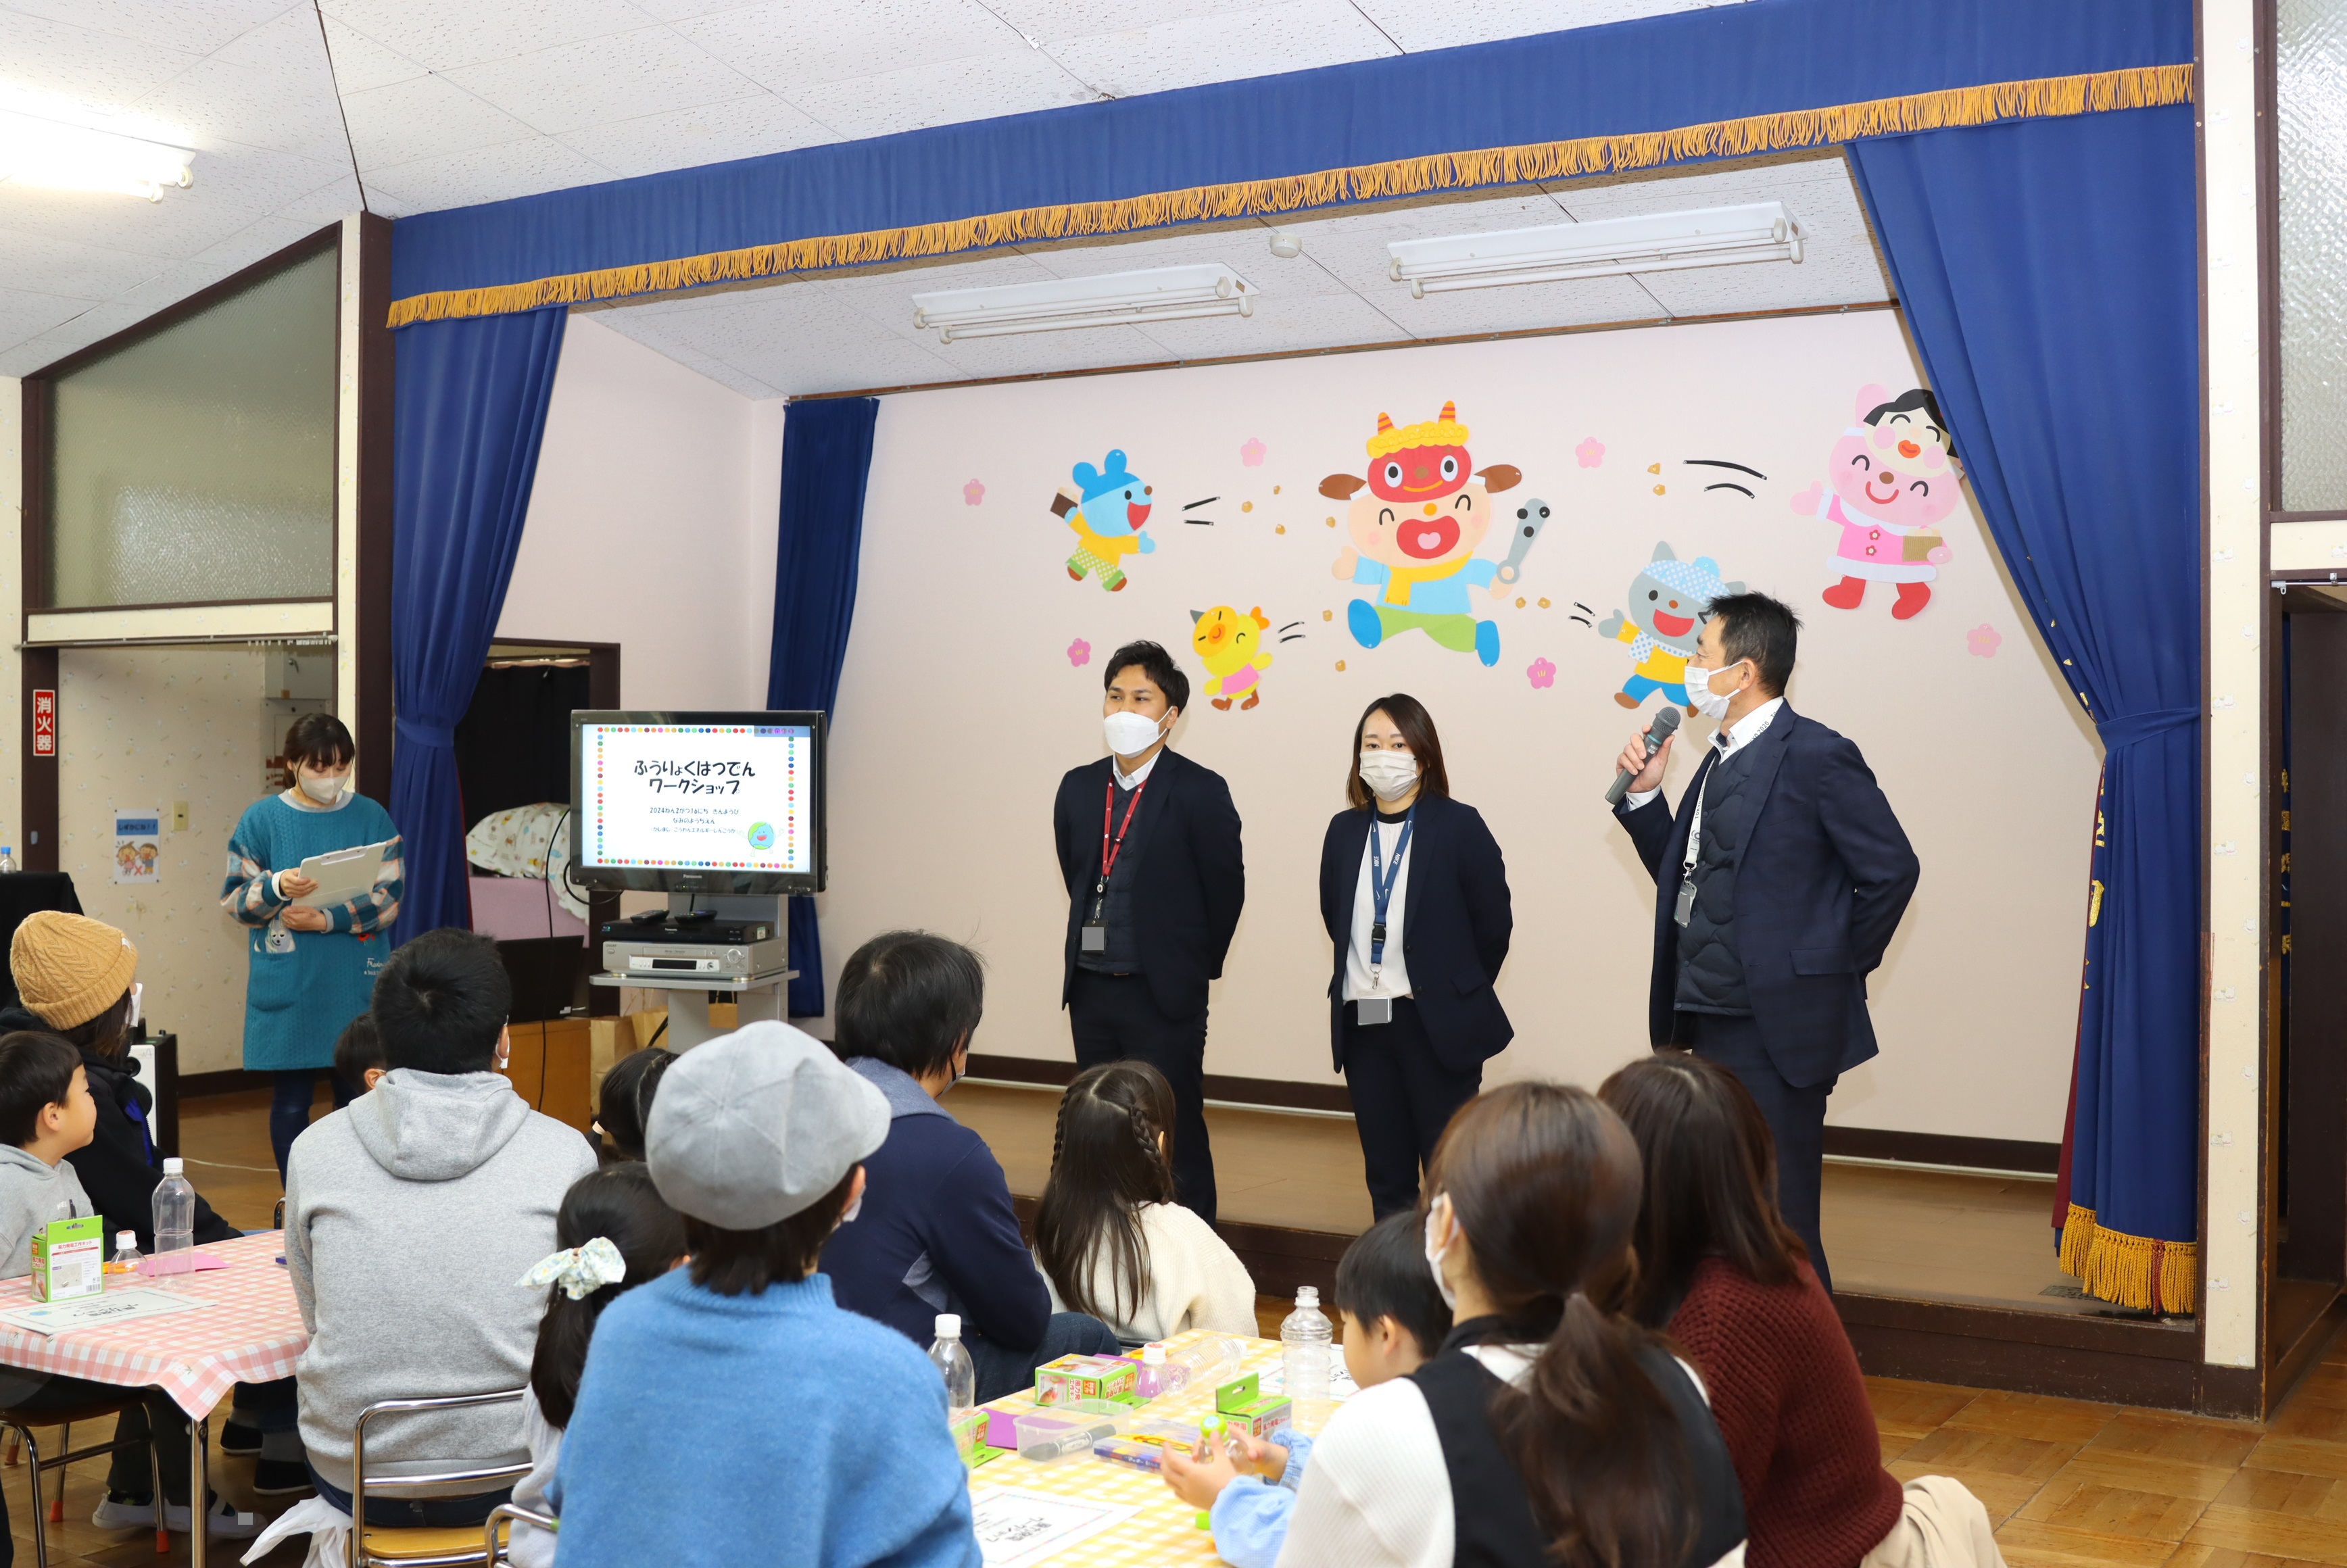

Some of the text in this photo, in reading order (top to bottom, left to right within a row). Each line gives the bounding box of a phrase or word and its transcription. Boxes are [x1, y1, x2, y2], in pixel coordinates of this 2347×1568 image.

[37, 697, 52, 751] 消火器
[1758, 721, 1770, 733] 2020
[634, 760, 756, 777] ふうりょくはつでん
[649, 778, 740, 795] ワークショップ
